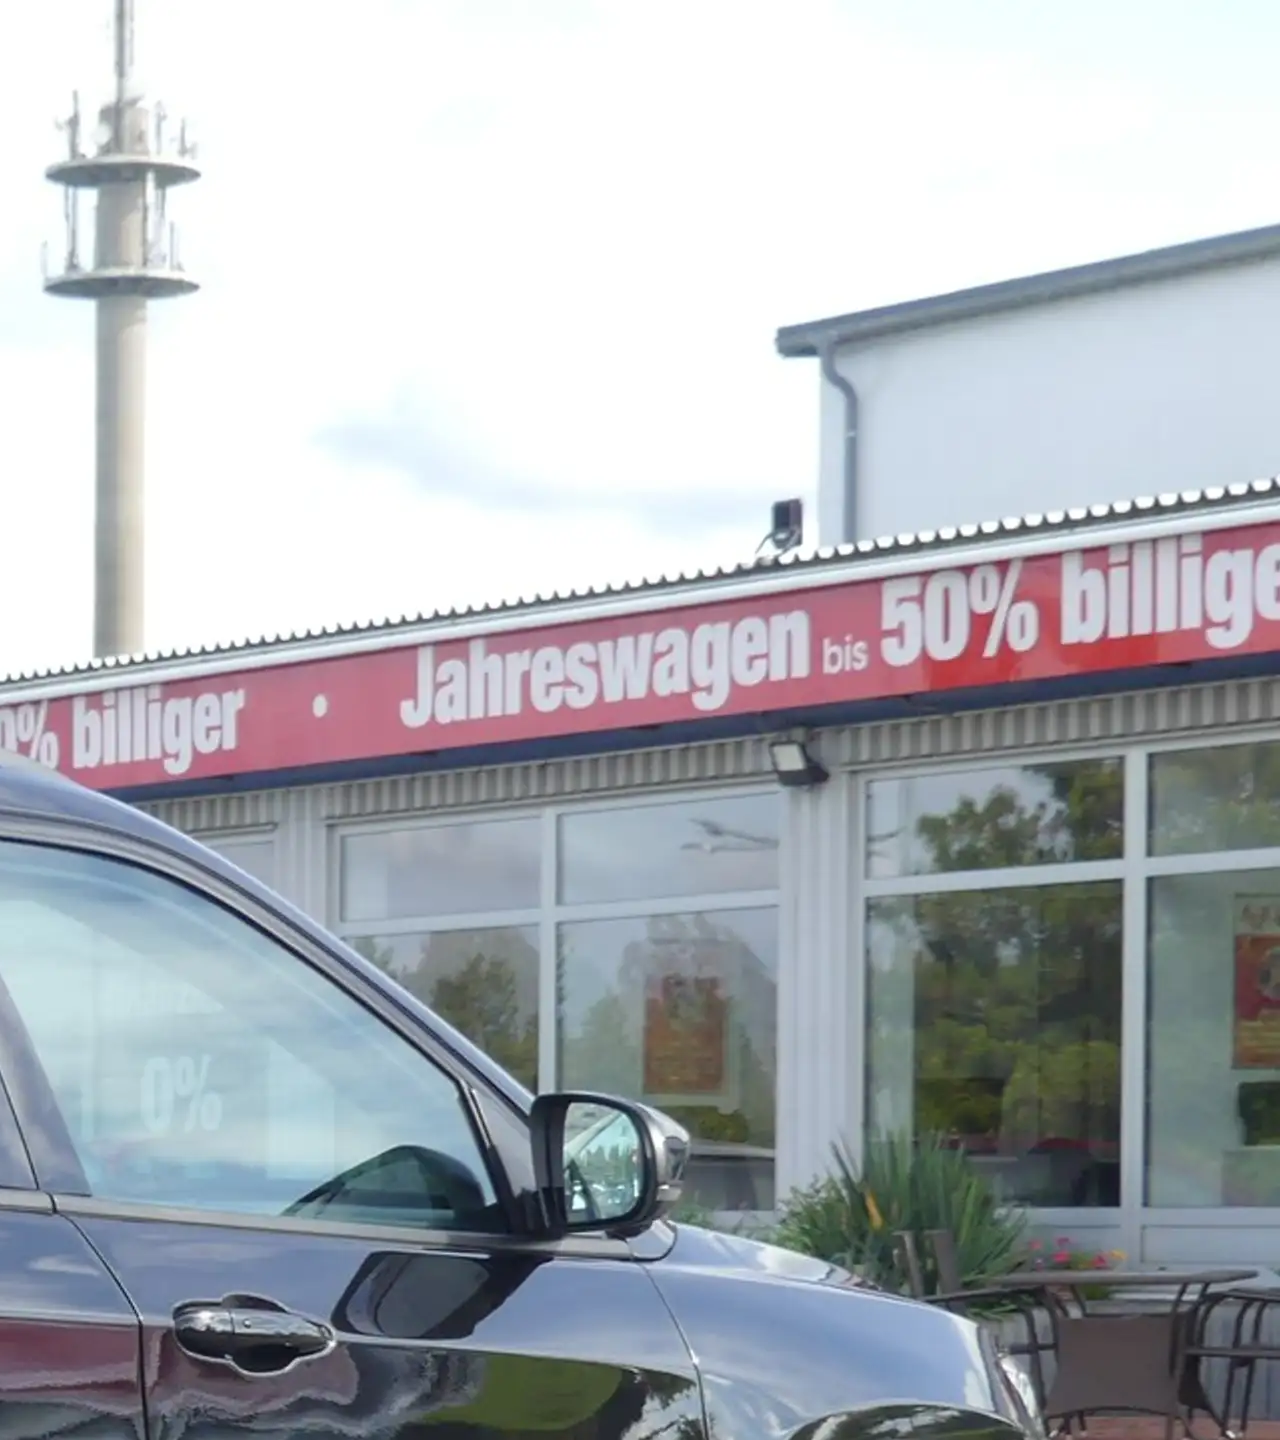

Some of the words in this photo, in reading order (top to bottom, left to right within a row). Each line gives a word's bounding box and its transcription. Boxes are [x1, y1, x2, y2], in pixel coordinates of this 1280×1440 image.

[73, 686, 244, 774] billiger
[400, 608, 810, 729] Jahreswagen
[823, 637, 869, 674] bis
[880, 557, 1039, 669] 50%
